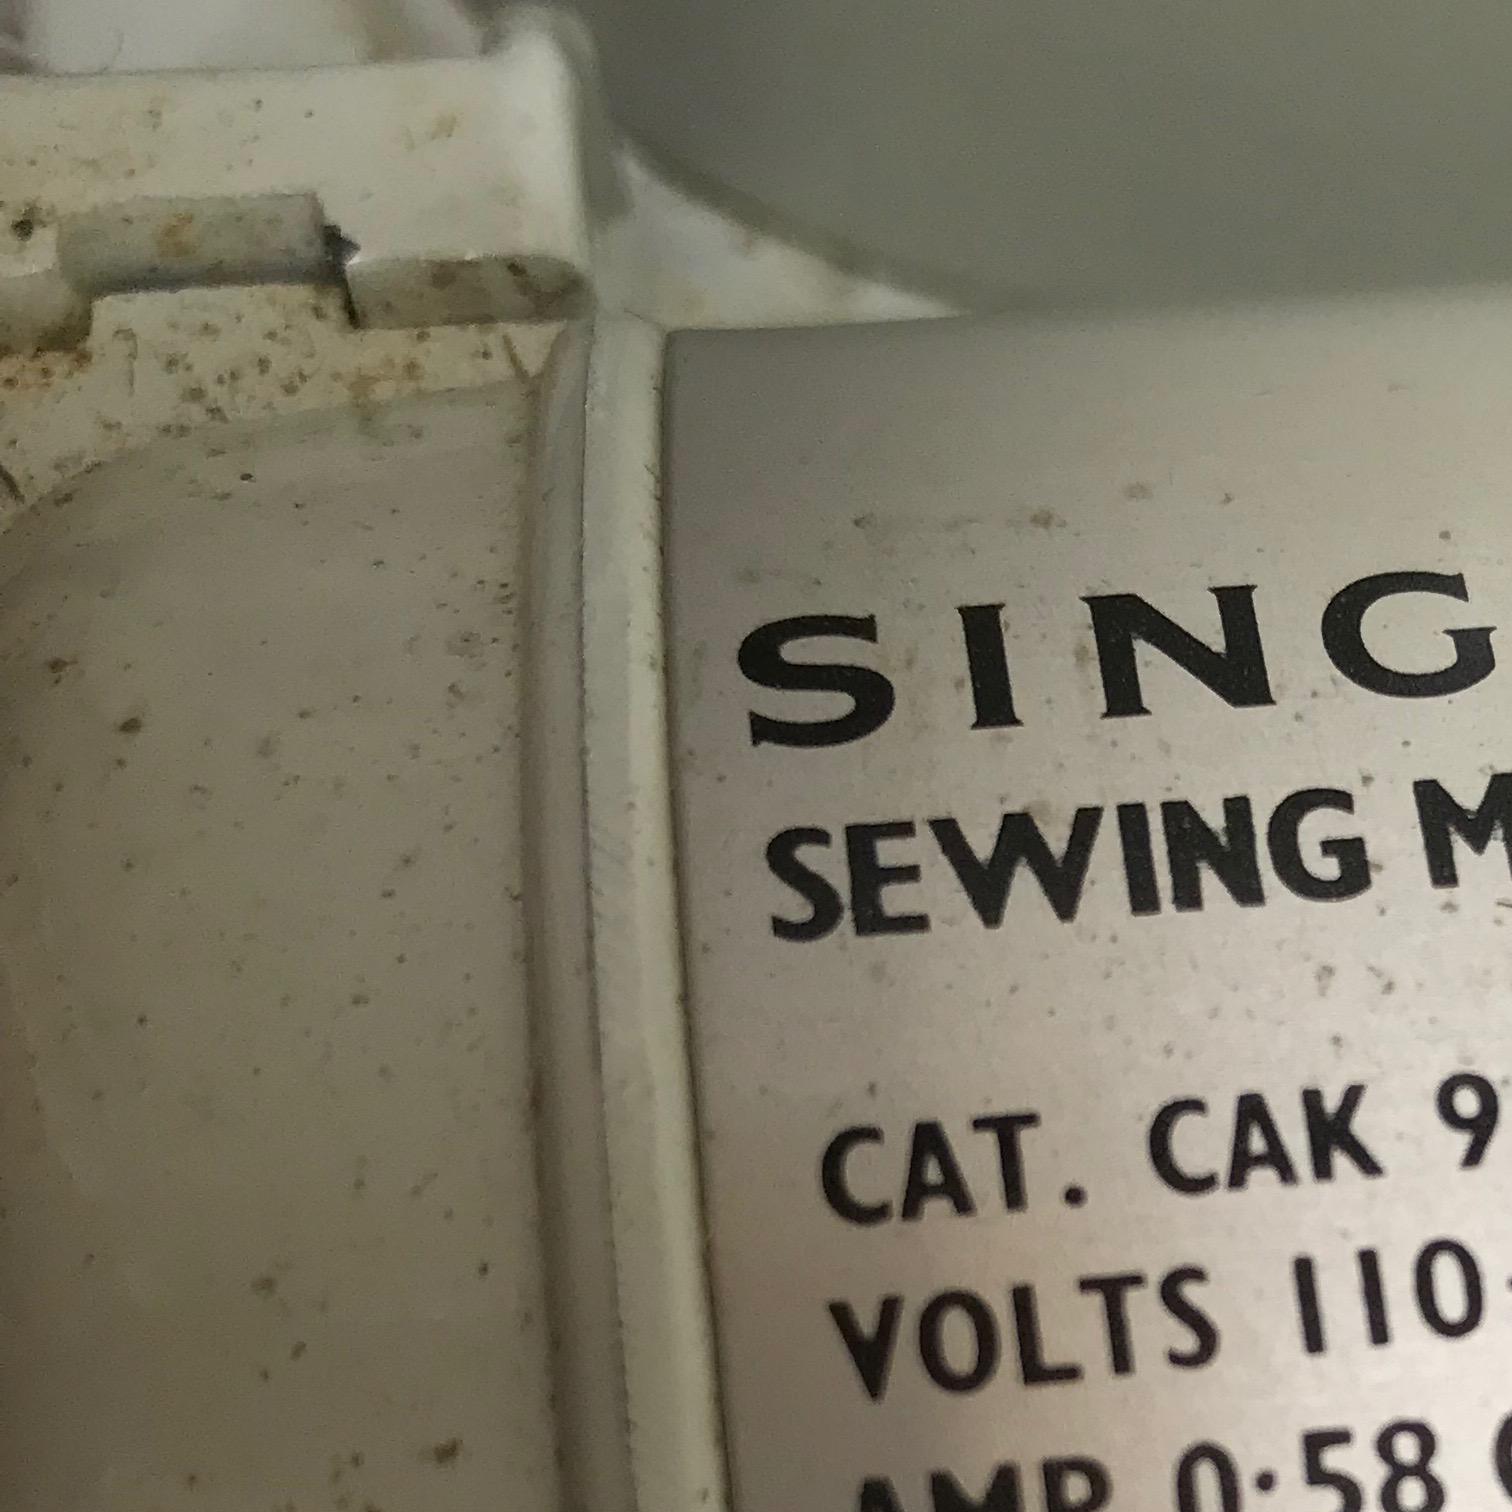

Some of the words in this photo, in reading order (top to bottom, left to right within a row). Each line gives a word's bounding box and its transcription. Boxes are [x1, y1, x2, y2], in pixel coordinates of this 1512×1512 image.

[765, 785, 1374, 944] SEWING
[820, 1111, 1087, 1222] CAT.
[1147, 1083, 1386, 1197] CAK
[828, 1264, 1221, 1402] VOLTS
